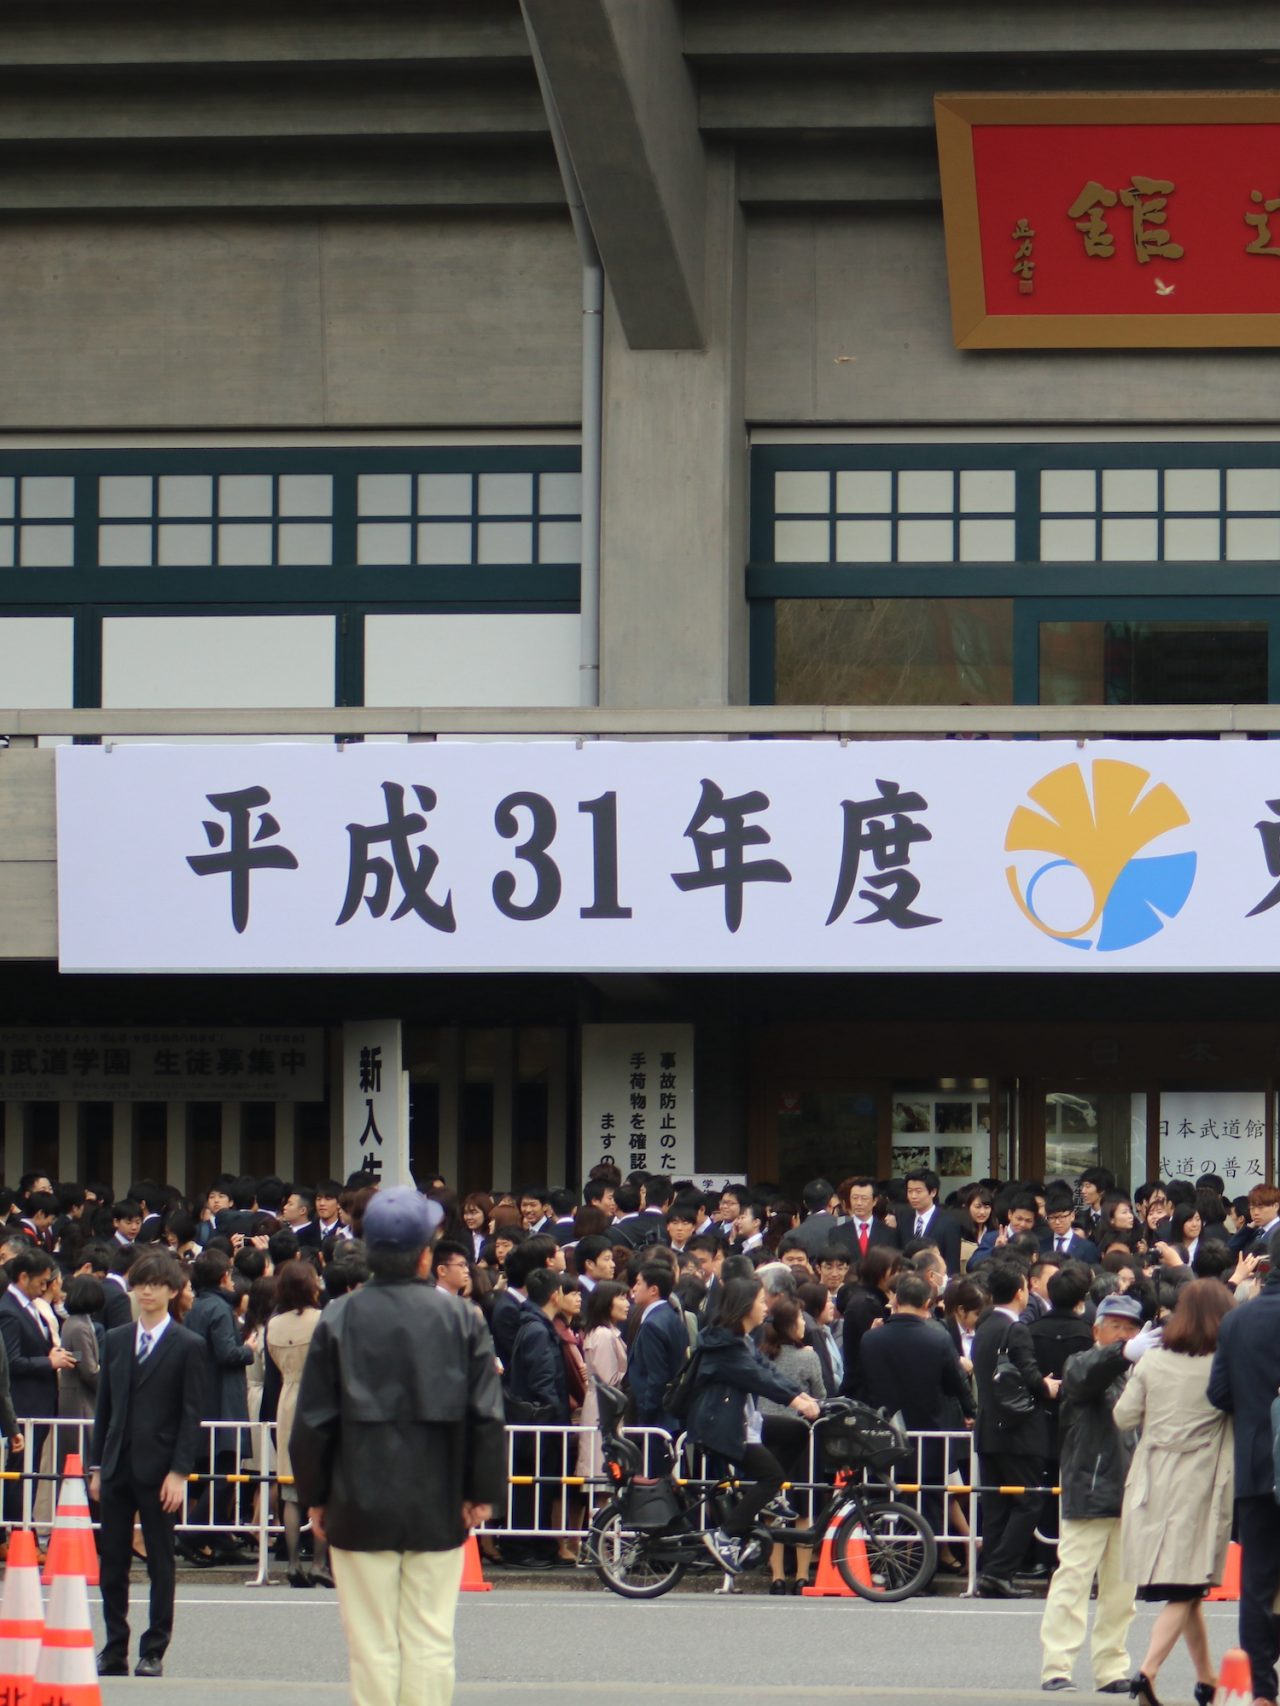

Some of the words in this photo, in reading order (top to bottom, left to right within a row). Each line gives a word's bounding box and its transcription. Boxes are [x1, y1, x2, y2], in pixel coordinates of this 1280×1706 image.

[184, 778, 943, 934] 平成31年度
[0, 1046, 129, 1076] 武道学園
